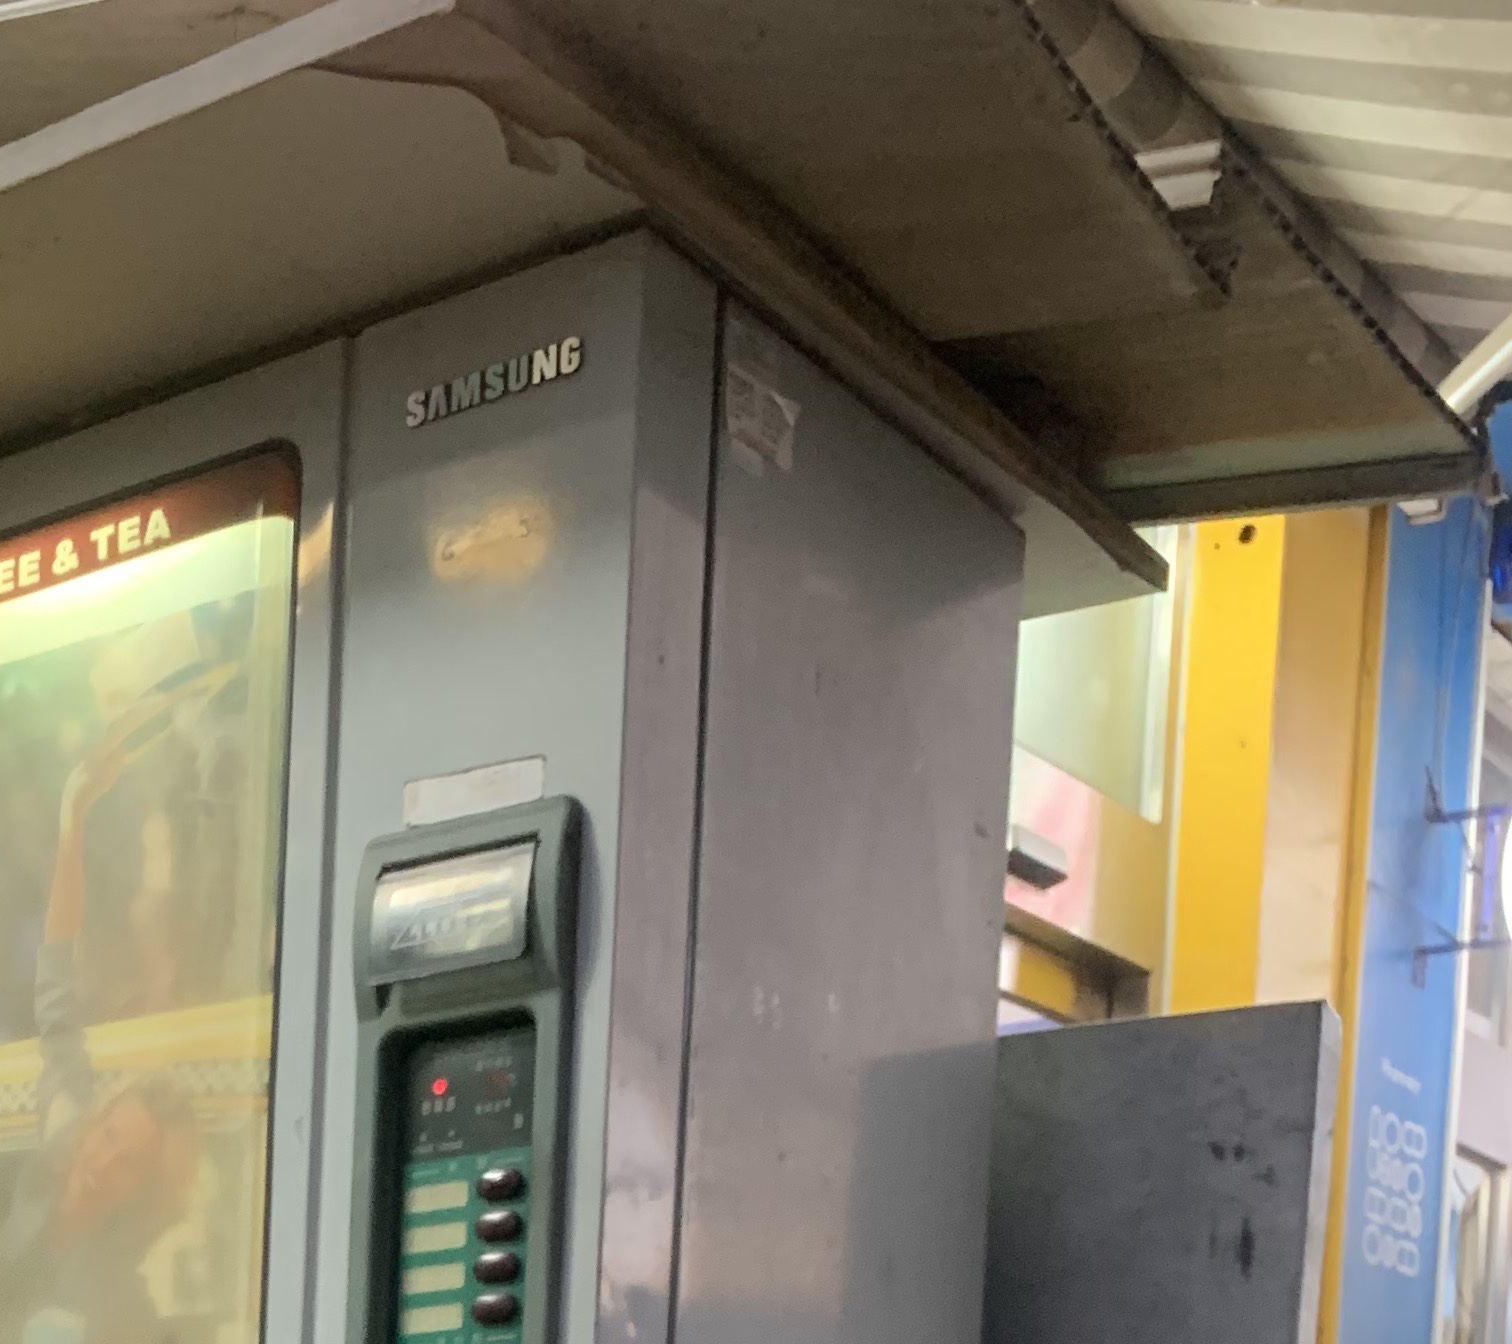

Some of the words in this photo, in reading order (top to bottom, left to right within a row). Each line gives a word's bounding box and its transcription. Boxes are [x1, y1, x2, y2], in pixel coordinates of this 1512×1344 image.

[405, 336, 582, 428] SAMSUNG
[52, 538, 79, 575] &
[90, 508, 172, 561] TEA
